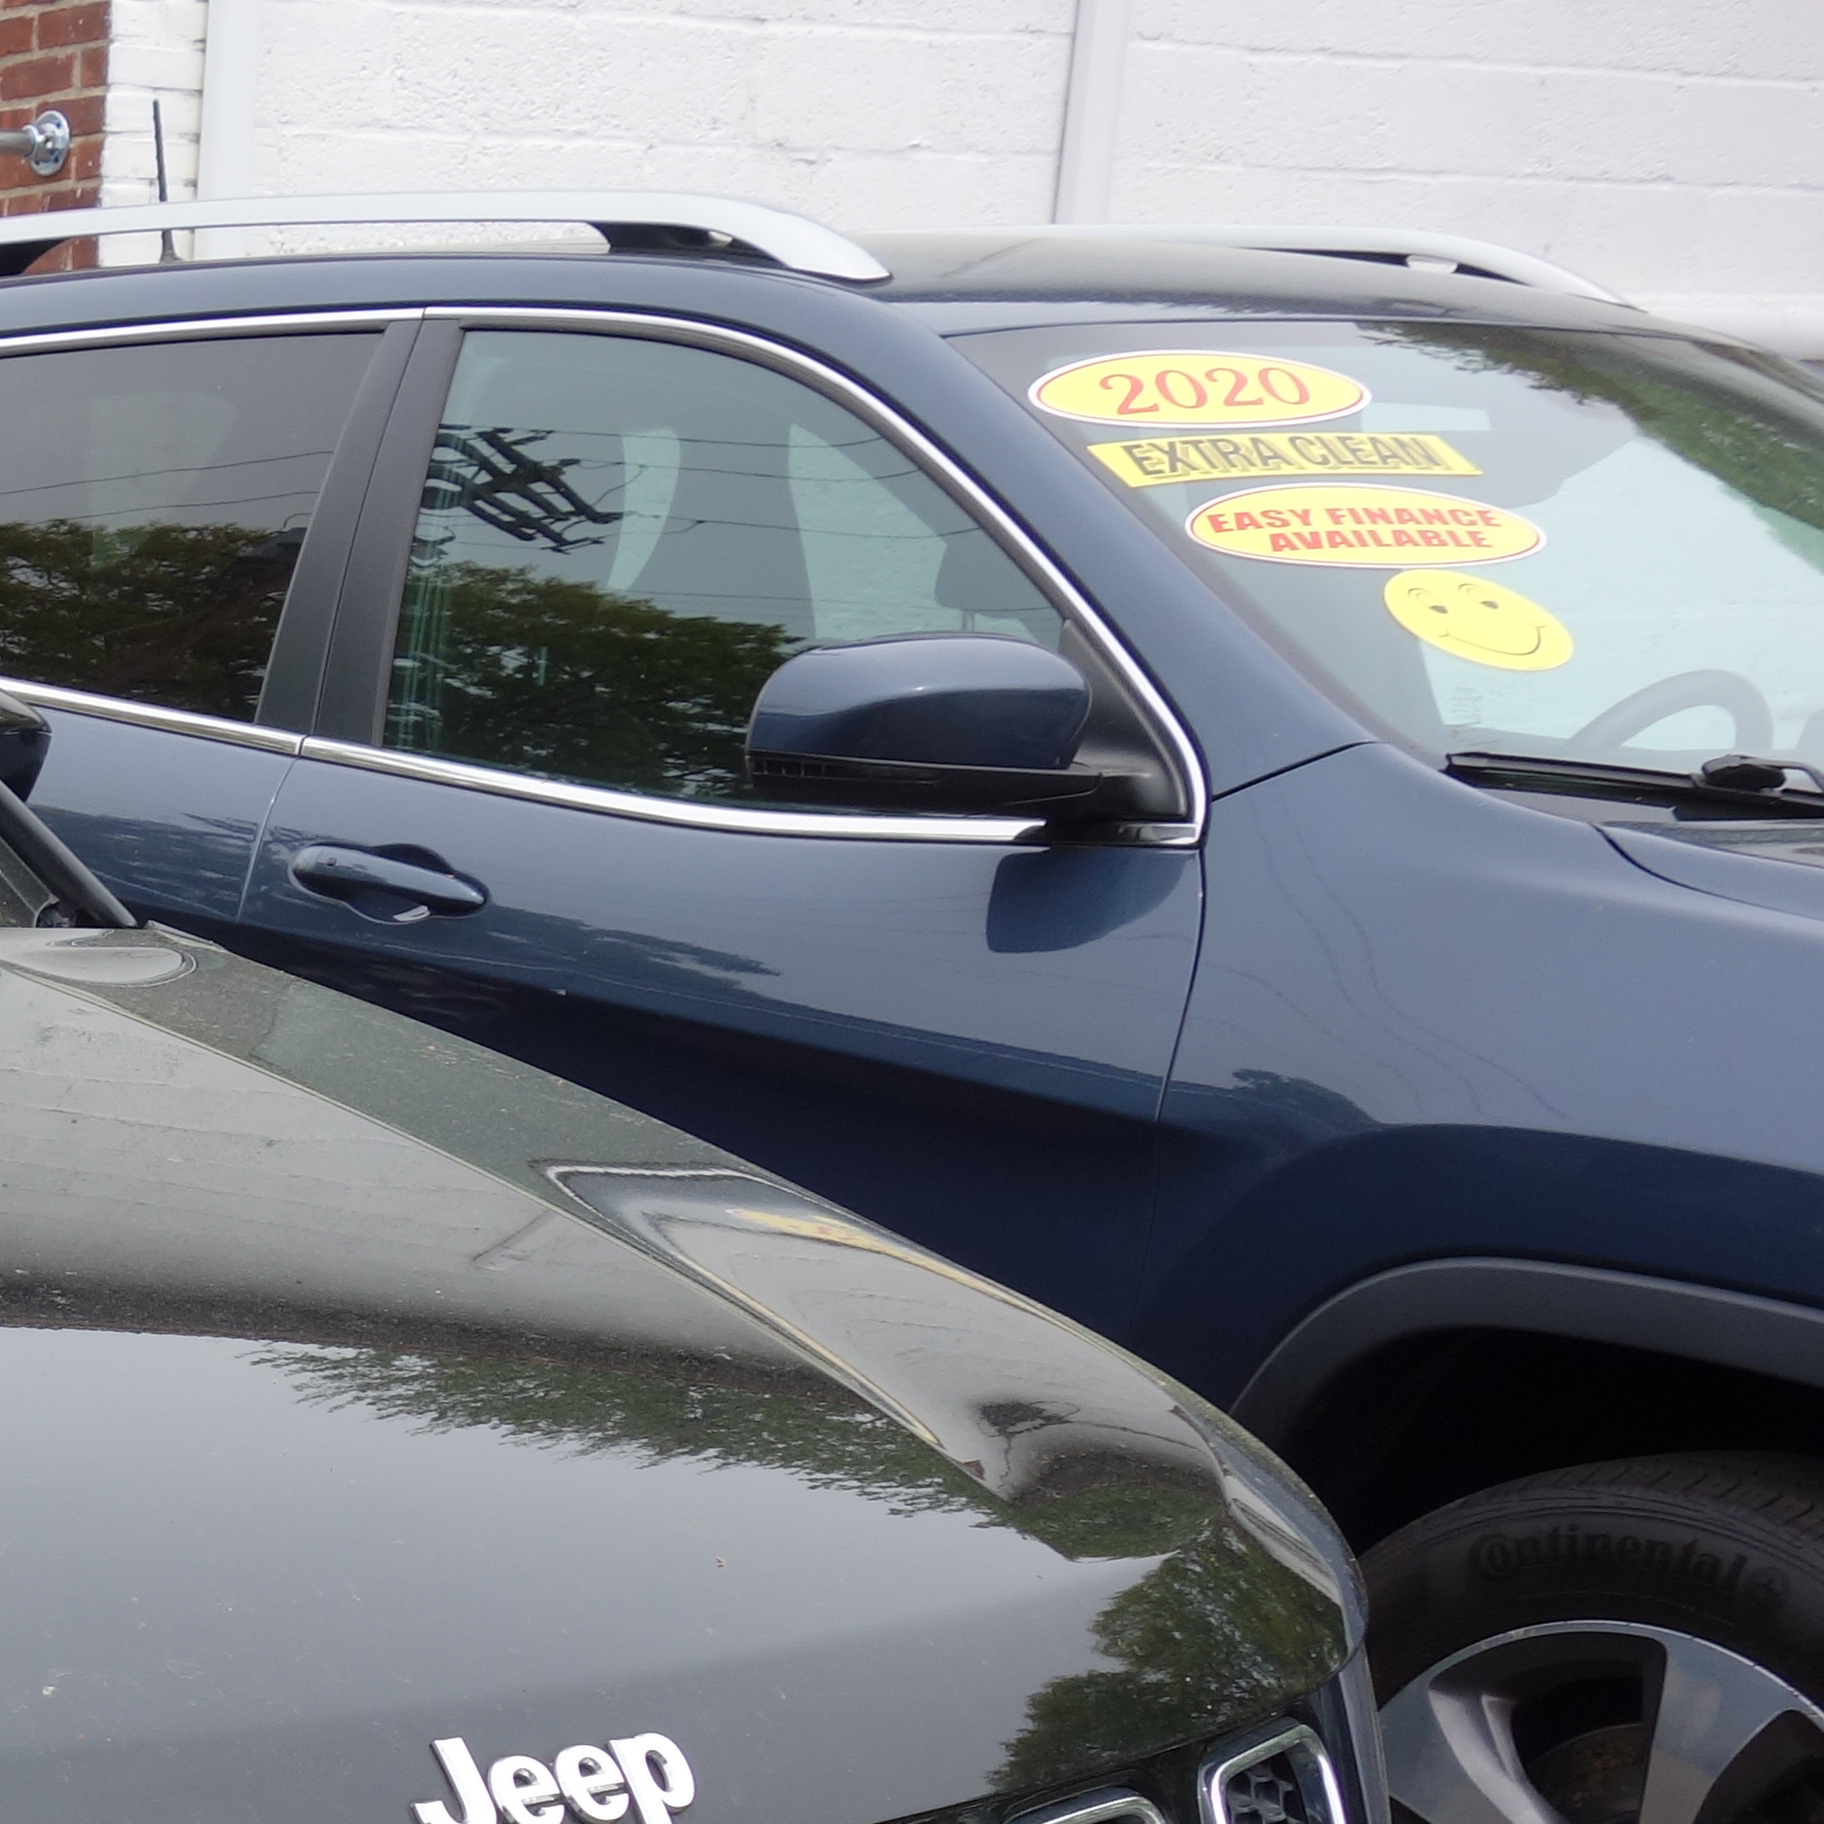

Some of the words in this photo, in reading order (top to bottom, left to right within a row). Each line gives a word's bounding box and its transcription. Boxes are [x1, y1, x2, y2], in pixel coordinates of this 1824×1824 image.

[1098, 367, 1311, 415] 2020
[1120, 436, 1292, 475] EXTRA
[1288, 434, 1444, 470] CLEAN
[1206, 509, 1312, 533] EASY
[1326, 508, 1502, 527] FINANCE
[1268, 529, 1493, 553] AVAILABLE
[1465, 1523, 1750, 1592] Continental
